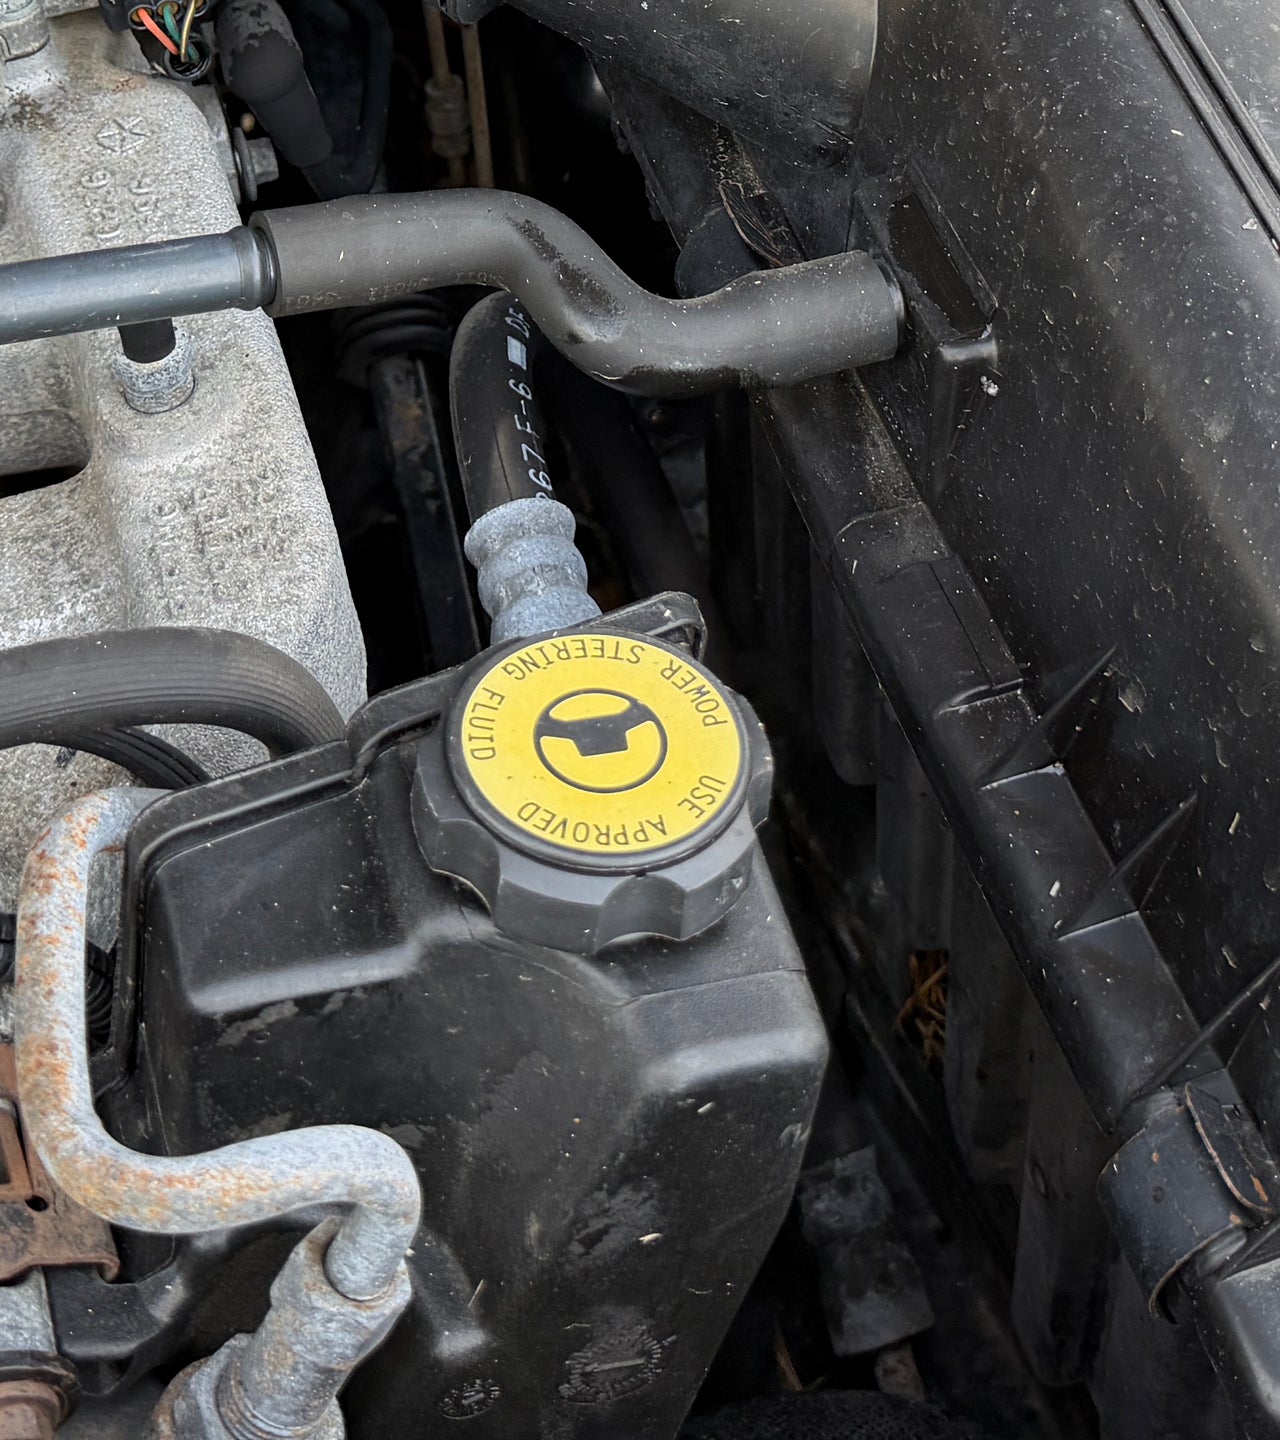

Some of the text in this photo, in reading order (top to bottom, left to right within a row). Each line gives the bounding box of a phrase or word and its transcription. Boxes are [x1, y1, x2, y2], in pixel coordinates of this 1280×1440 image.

[470, 637, 729, 762] POWER STEERING FLUID
[516, 773, 729, 847] USE APPROVED
